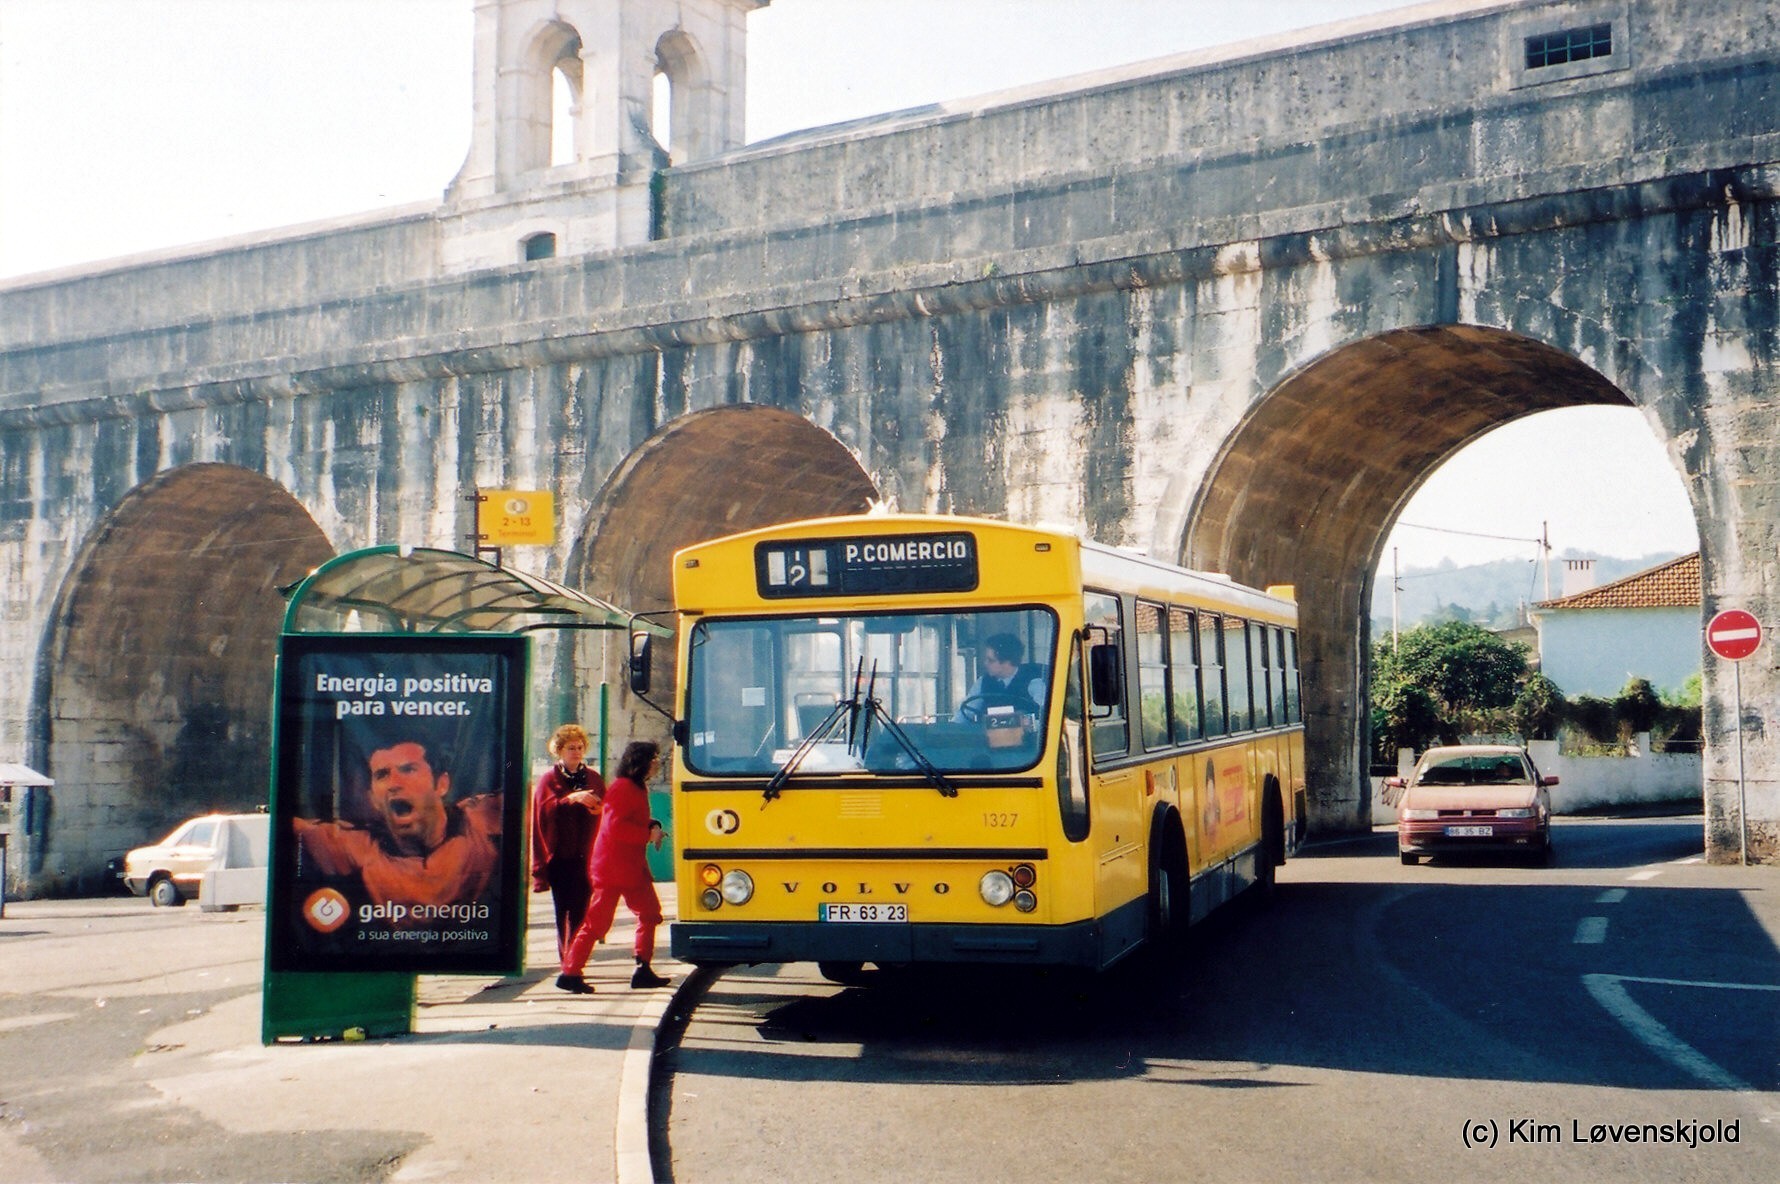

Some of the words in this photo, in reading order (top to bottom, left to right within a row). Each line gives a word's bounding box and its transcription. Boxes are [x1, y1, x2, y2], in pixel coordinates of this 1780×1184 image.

[503, 517, 509, 526] 2
[520, 517, 531, 526] 13
[316, 672, 397, 698] Energia
[404, 672, 492, 698] positiva
[336, 700, 385, 720] para
[391, 700, 471, 716] vencer.
[983, 812, 1018, 828] 1327
[782, 882, 951, 895] VOLVO
[358, 900, 407, 923] galp
[411, 901, 490, 924] energia
[358, 930, 365, 940] a
[368, 930, 390, 940] sua
[392, 928, 439, 943] energia
[442, 928, 489, 942] positiva
